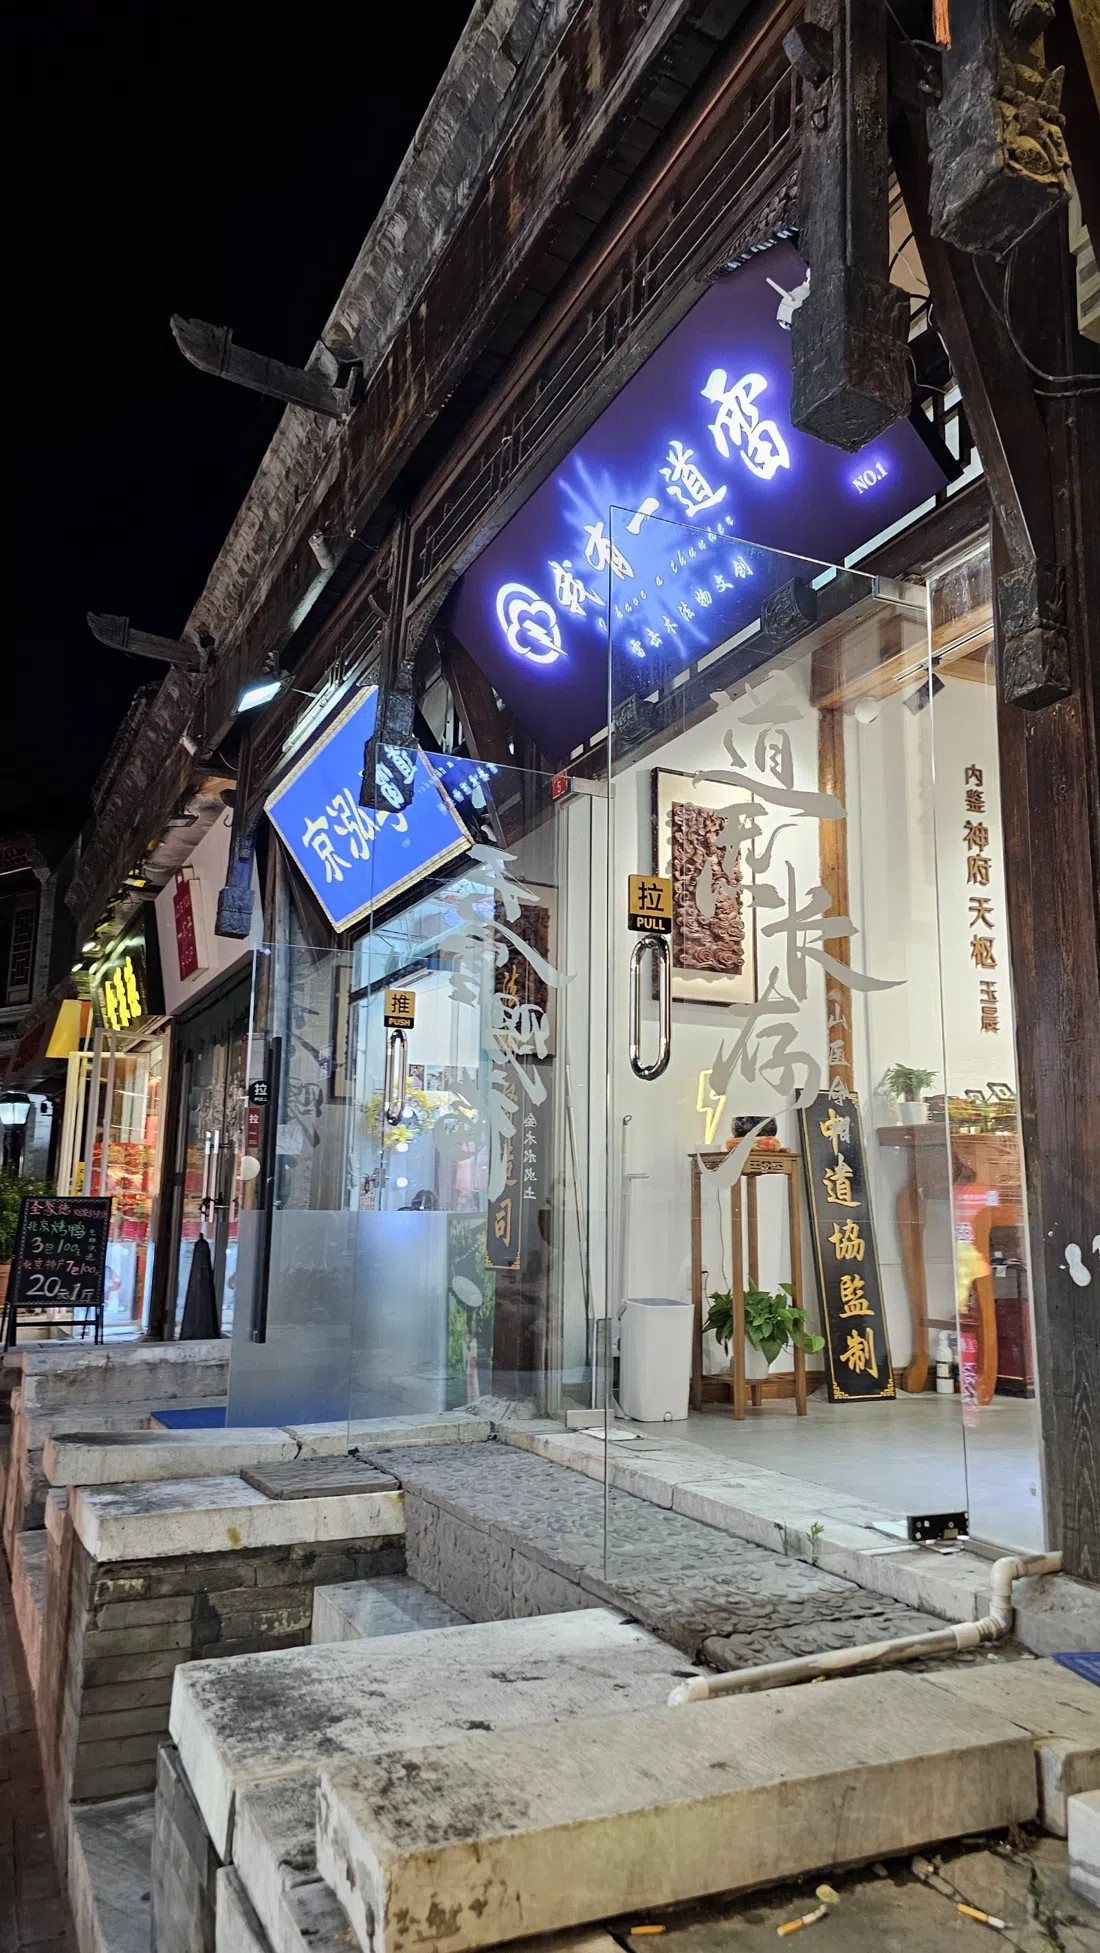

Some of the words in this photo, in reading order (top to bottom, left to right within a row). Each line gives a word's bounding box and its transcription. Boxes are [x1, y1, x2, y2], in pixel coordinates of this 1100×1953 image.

[852, 462, 888, 495] NO.1
[548, 368, 789, 616] 我有一道雷
[670, 515, 735, 574] thunder
[638, 881, 665, 912] 拉
[636, 916, 666, 931] PULL
[391, 993, 410, 1014] 推
[388, 1017, 411, 1027] PUSH
[254, 1083, 268, 1096] 拉
[249, 1113, 260, 1124] 拉
[27, 1219, 86, 1239] 北京烤鸭
